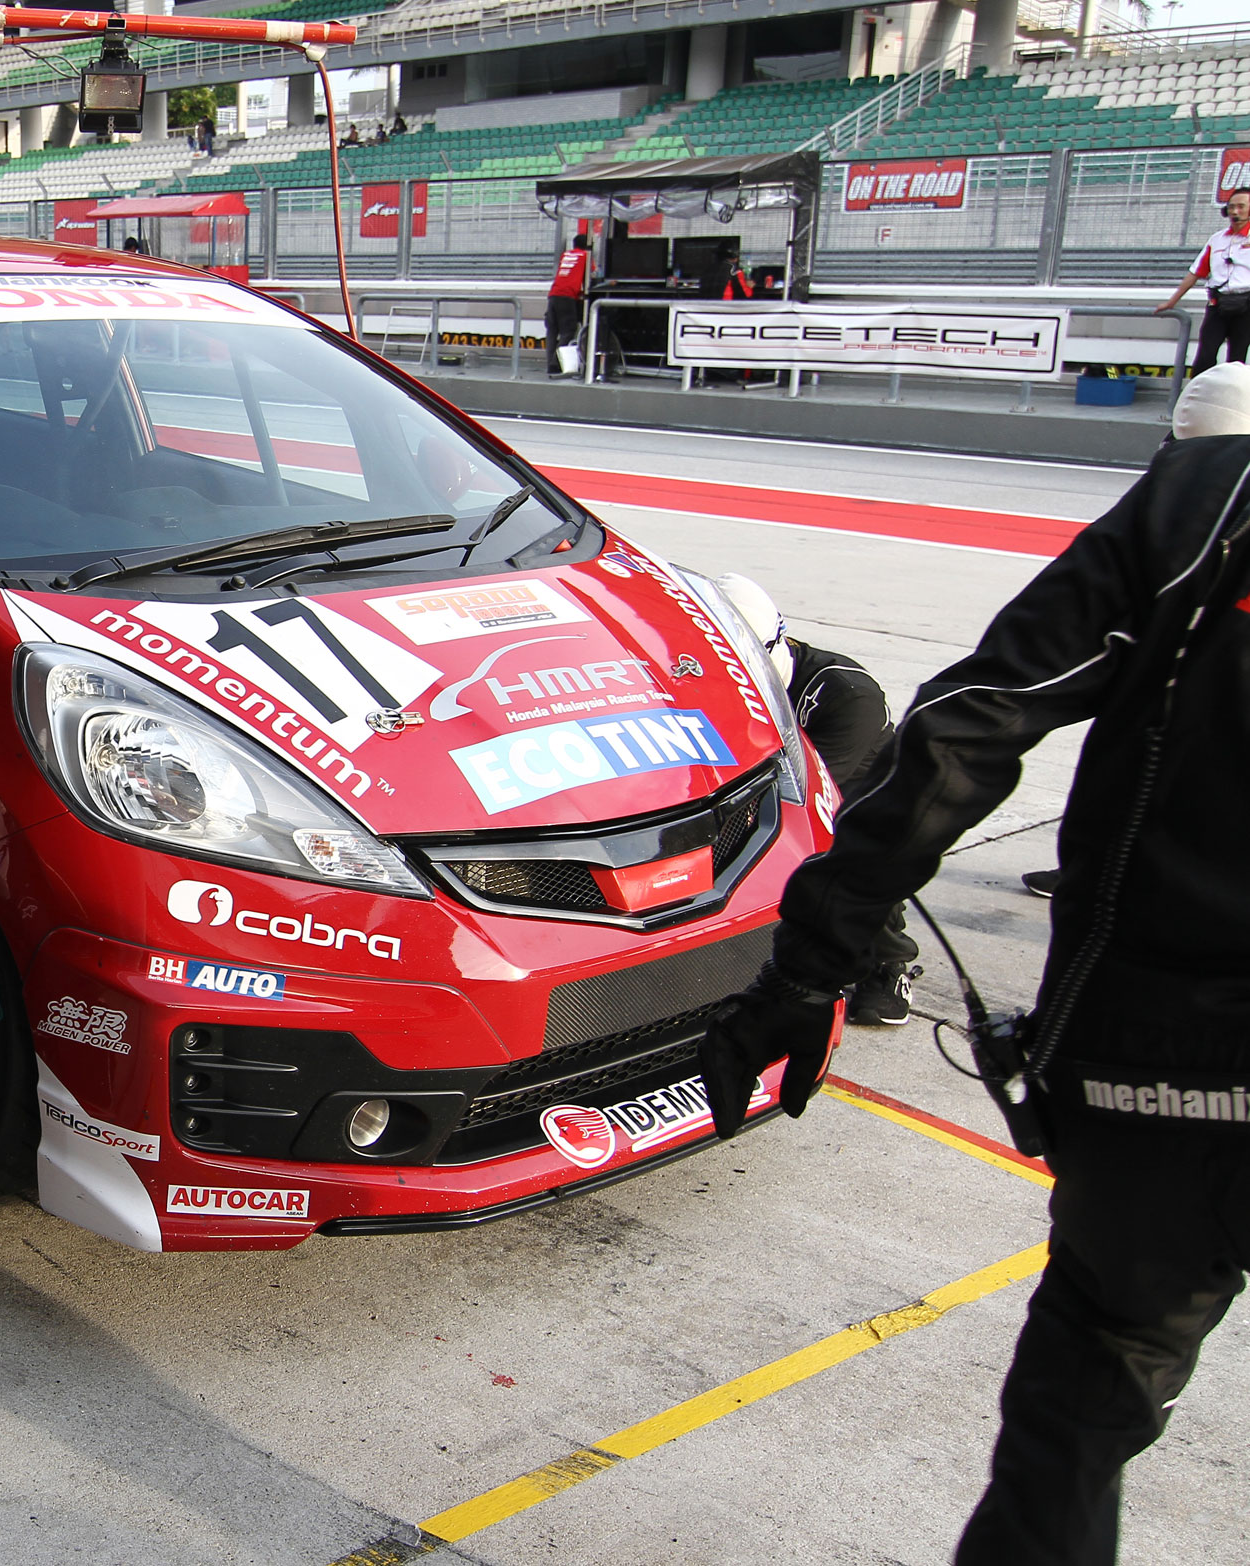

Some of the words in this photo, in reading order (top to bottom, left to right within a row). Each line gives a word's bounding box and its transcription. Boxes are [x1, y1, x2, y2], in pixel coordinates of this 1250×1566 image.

[847, 175, 876, 200] ON
[875, 173, 910, 199] THE
[908, 171, 963, 198] ROAD
[680, 325, 1041, 348] RACETECH
[395, 584, 539, 619] Sepang
[206, 598, 402, 724] 17
[90, 608, 372, 798] momentum
[484, 659, 657, 706] HMRT
[506, 707, 550, 724] Honda
[549, 697, 607, 716] Malaysia
[606, 691, 649, 708] Racing
[235, 910, 402, 960] cobra
[149, 956, 185, 979] BH
[191, 965, 278, 998] AUTO
[38, 1020, 79, 1040] MUGEN
[82, 1034, 131, 1054] POWER
[41, 1099, 157, 1154] TedcoSport
[607, 1077, 714, 1136] IDEMI
[170, 1187, 305, 1212] AUTOCAR
